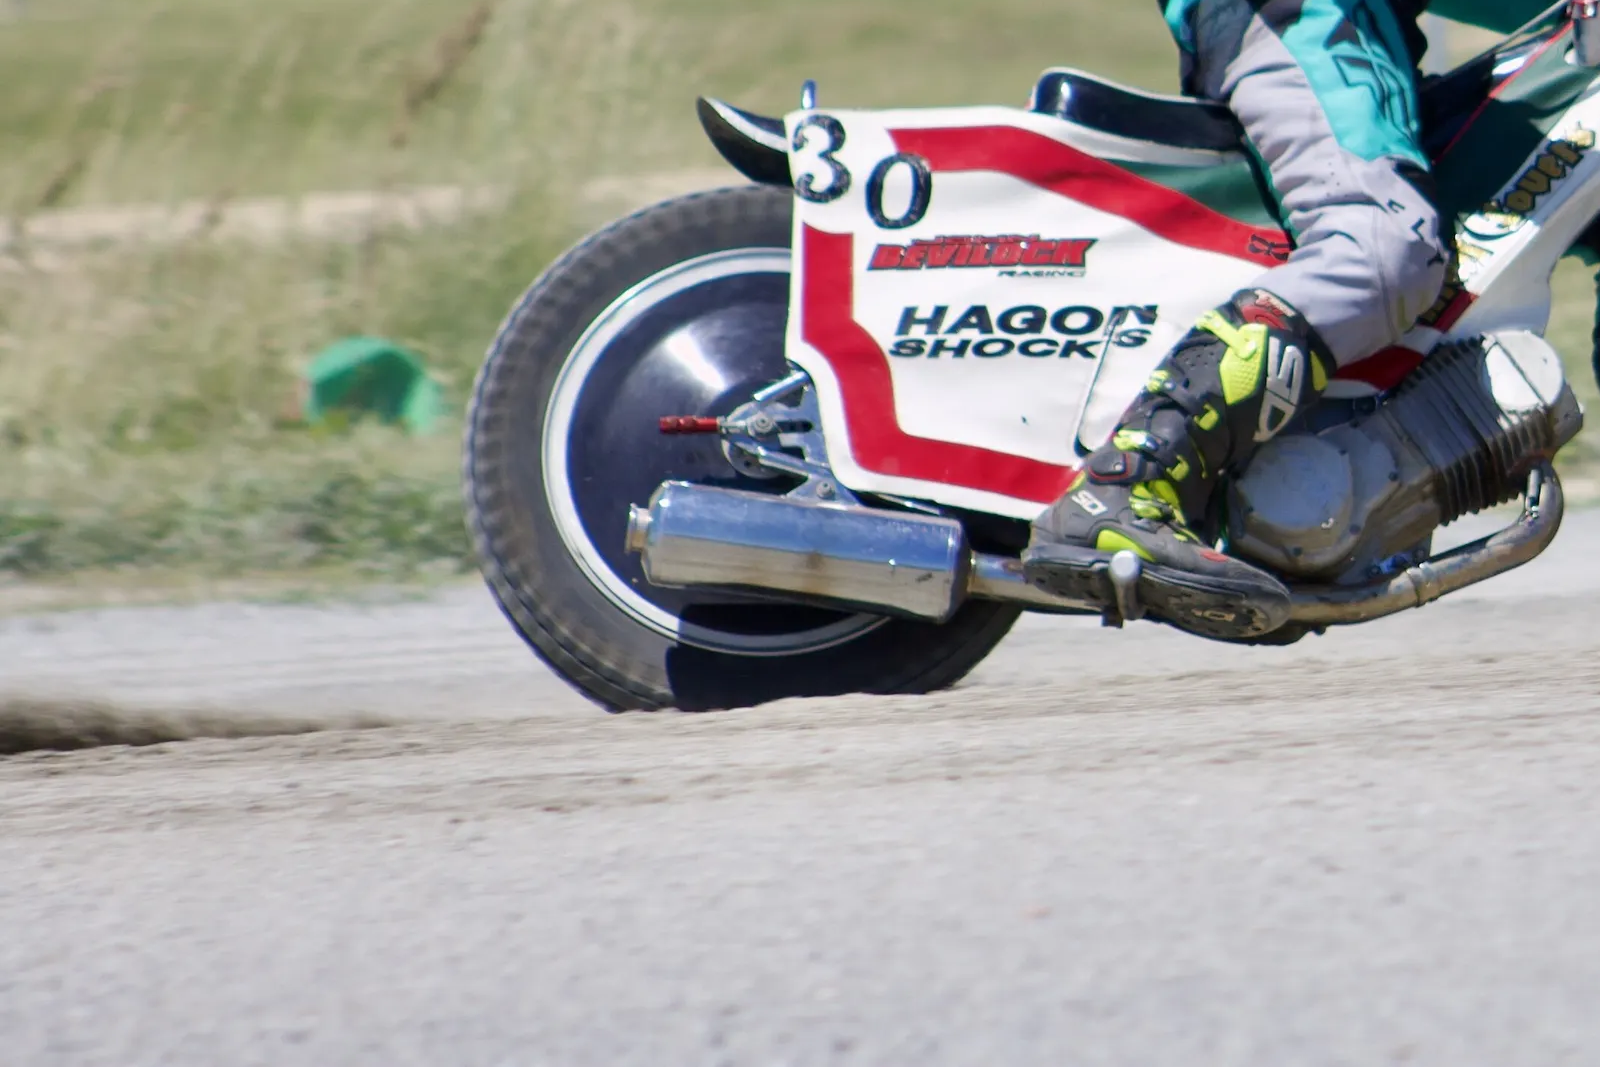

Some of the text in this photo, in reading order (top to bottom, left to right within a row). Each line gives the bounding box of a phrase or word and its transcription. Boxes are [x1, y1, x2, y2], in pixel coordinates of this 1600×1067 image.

[793, 114, 932, 230] 30
[867, 238, 1099, 271] DEVILOCK
[894, 305, 1158, 336] HAGON
[889, 329, 1152, 358] SHOCKS
